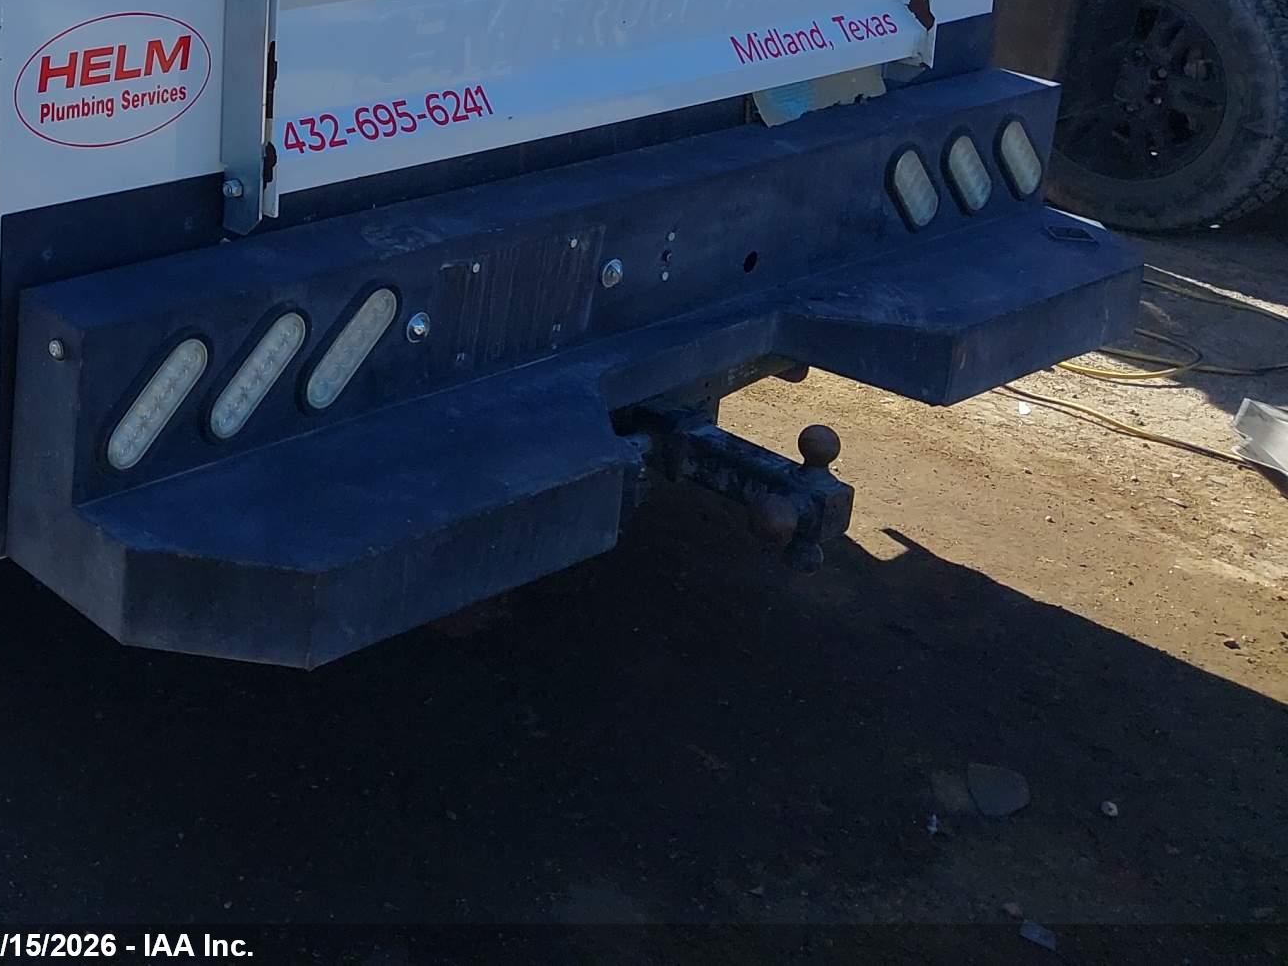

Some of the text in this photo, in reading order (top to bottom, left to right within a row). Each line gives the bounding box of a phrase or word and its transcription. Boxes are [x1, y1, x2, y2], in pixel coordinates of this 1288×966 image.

[38, 35, 192, 93] HELM
[730, 13, 898, 65] Midland, Texas
[40, 85, 187, 124] Plumbing Services
[284, 85, 494, 154] 432-695-6241
